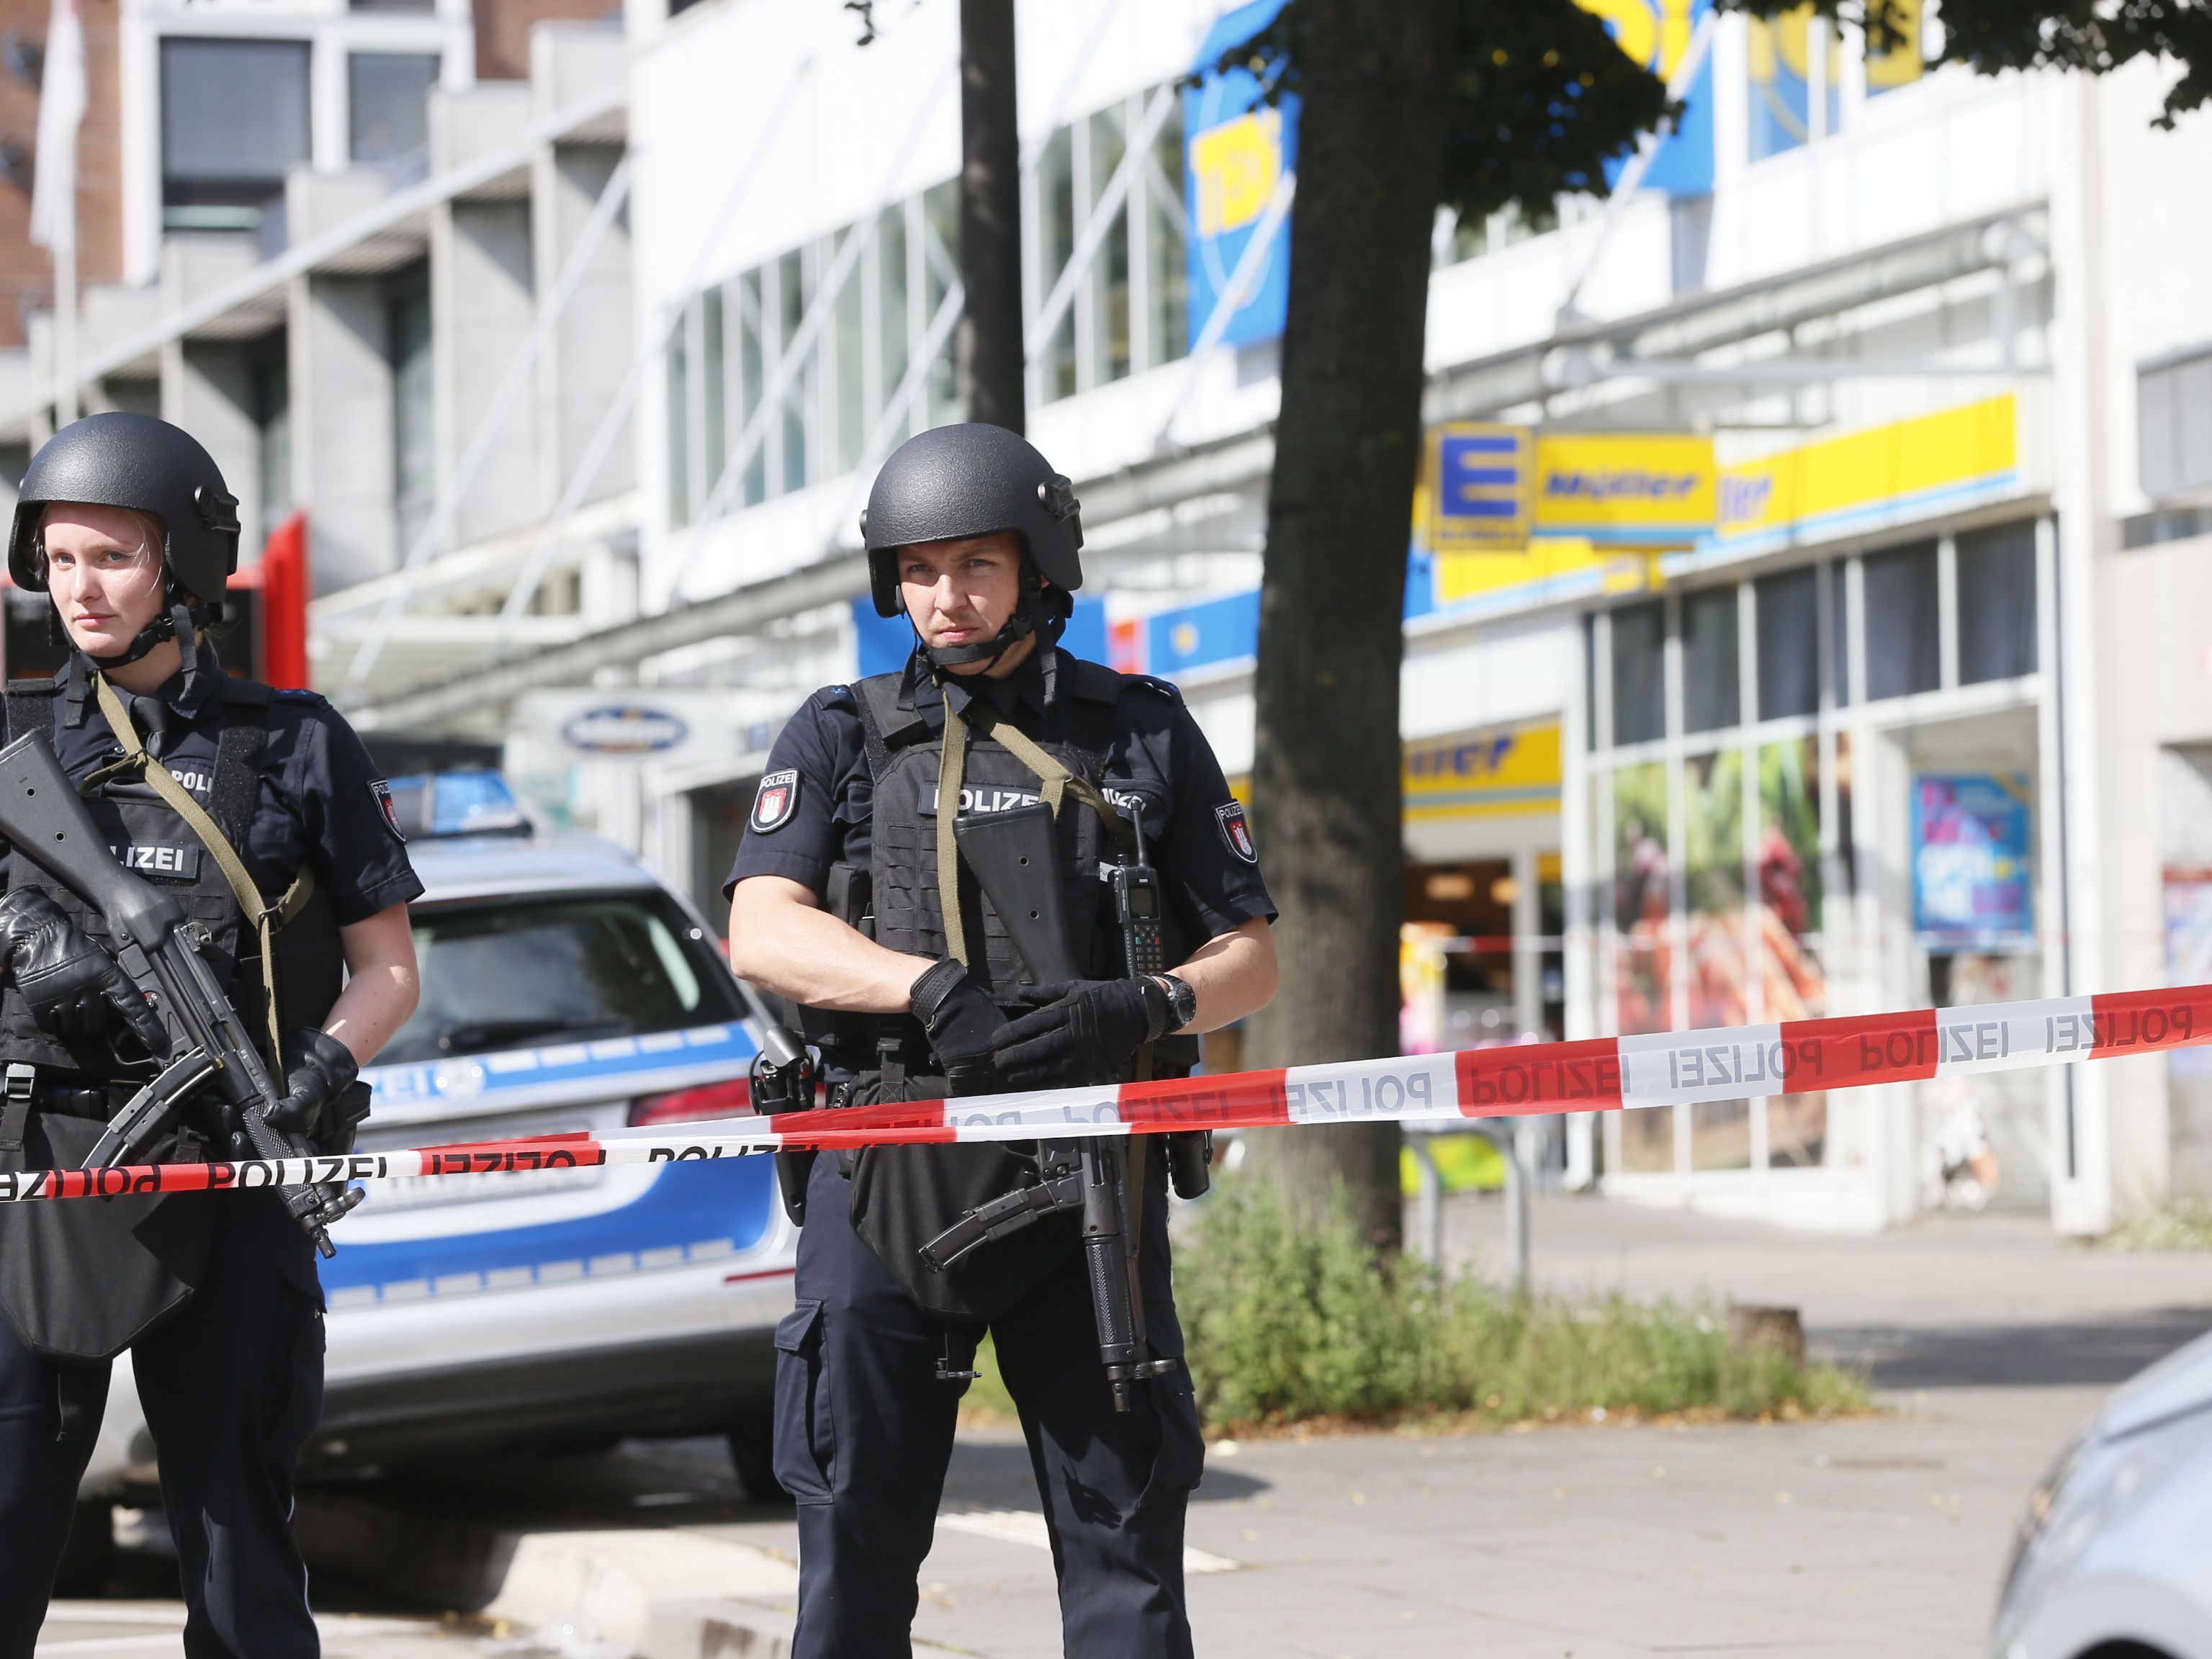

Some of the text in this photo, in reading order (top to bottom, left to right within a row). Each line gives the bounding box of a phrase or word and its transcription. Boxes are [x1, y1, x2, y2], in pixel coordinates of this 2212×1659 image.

[171, 770, 213, 793] POLI
[761, 773, 794, 788] POLIZEI
[933, 788, 1039, 812] OLIZE
[207, 1156, 387, 1189] POLIZEI
[0, 1168, 161, 1202] POLIZE
